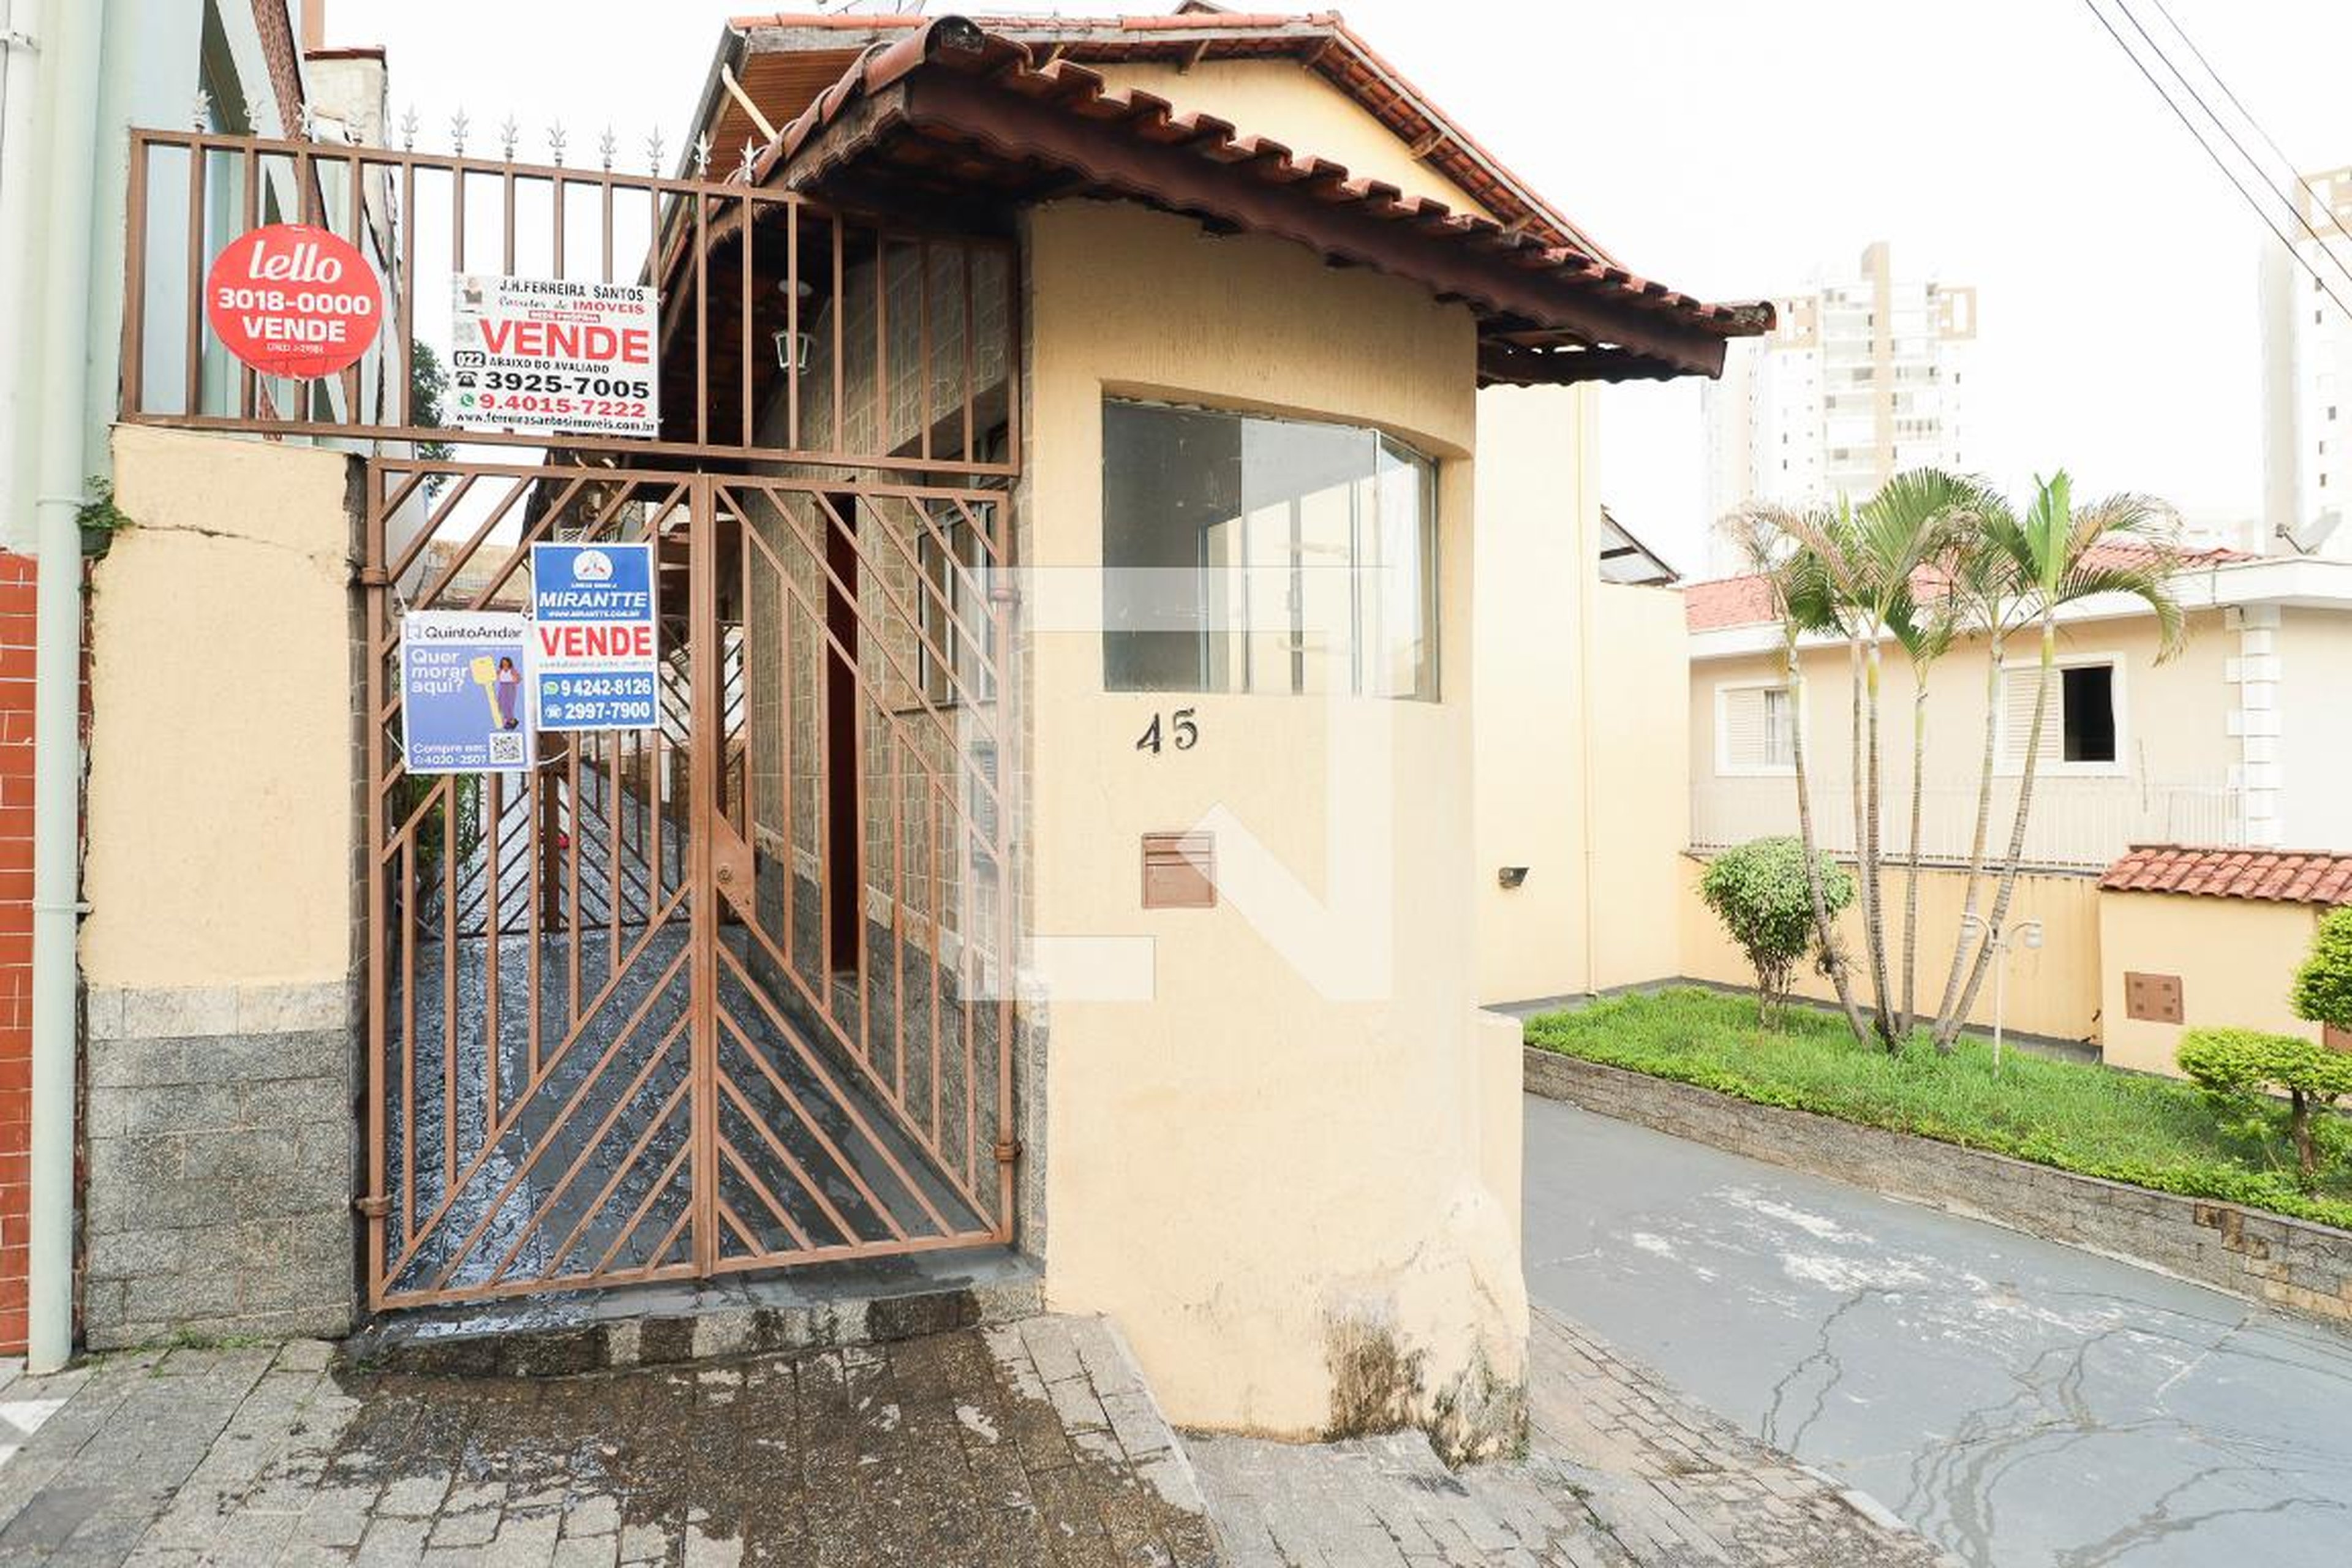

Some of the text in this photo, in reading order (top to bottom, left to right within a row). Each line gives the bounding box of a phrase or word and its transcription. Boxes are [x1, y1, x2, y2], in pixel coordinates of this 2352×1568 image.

[217, 287, 372, 315] 3018-0000
[594, 285, 645, 302] SANTOS
[242, 315, 347, 343] VENDE
[478, 318, 650, 364] VENDE
[489, 357, 609, 374] ABAIXO DO AVALIADO
[484, 371, 650, 399] 3925-7005
[479, 393, 647, 418] 9.4015-7222
[539, 591, 648, 608] MIRANTTE
[424, 626, 522, 639] QuintoAndar
[539, 626, 652, 657] VENDE
[411, 649, 461, 664] Quer
[412, 666, 469, 679] morar
[412, 679, 464, 696] aqui?
[561, 679, 571, 696] 9
[565, 701, 651, 720] 2997-7900
[1136, 707, 1199, 754] 45
[412, 743, 463, 755] Compre
